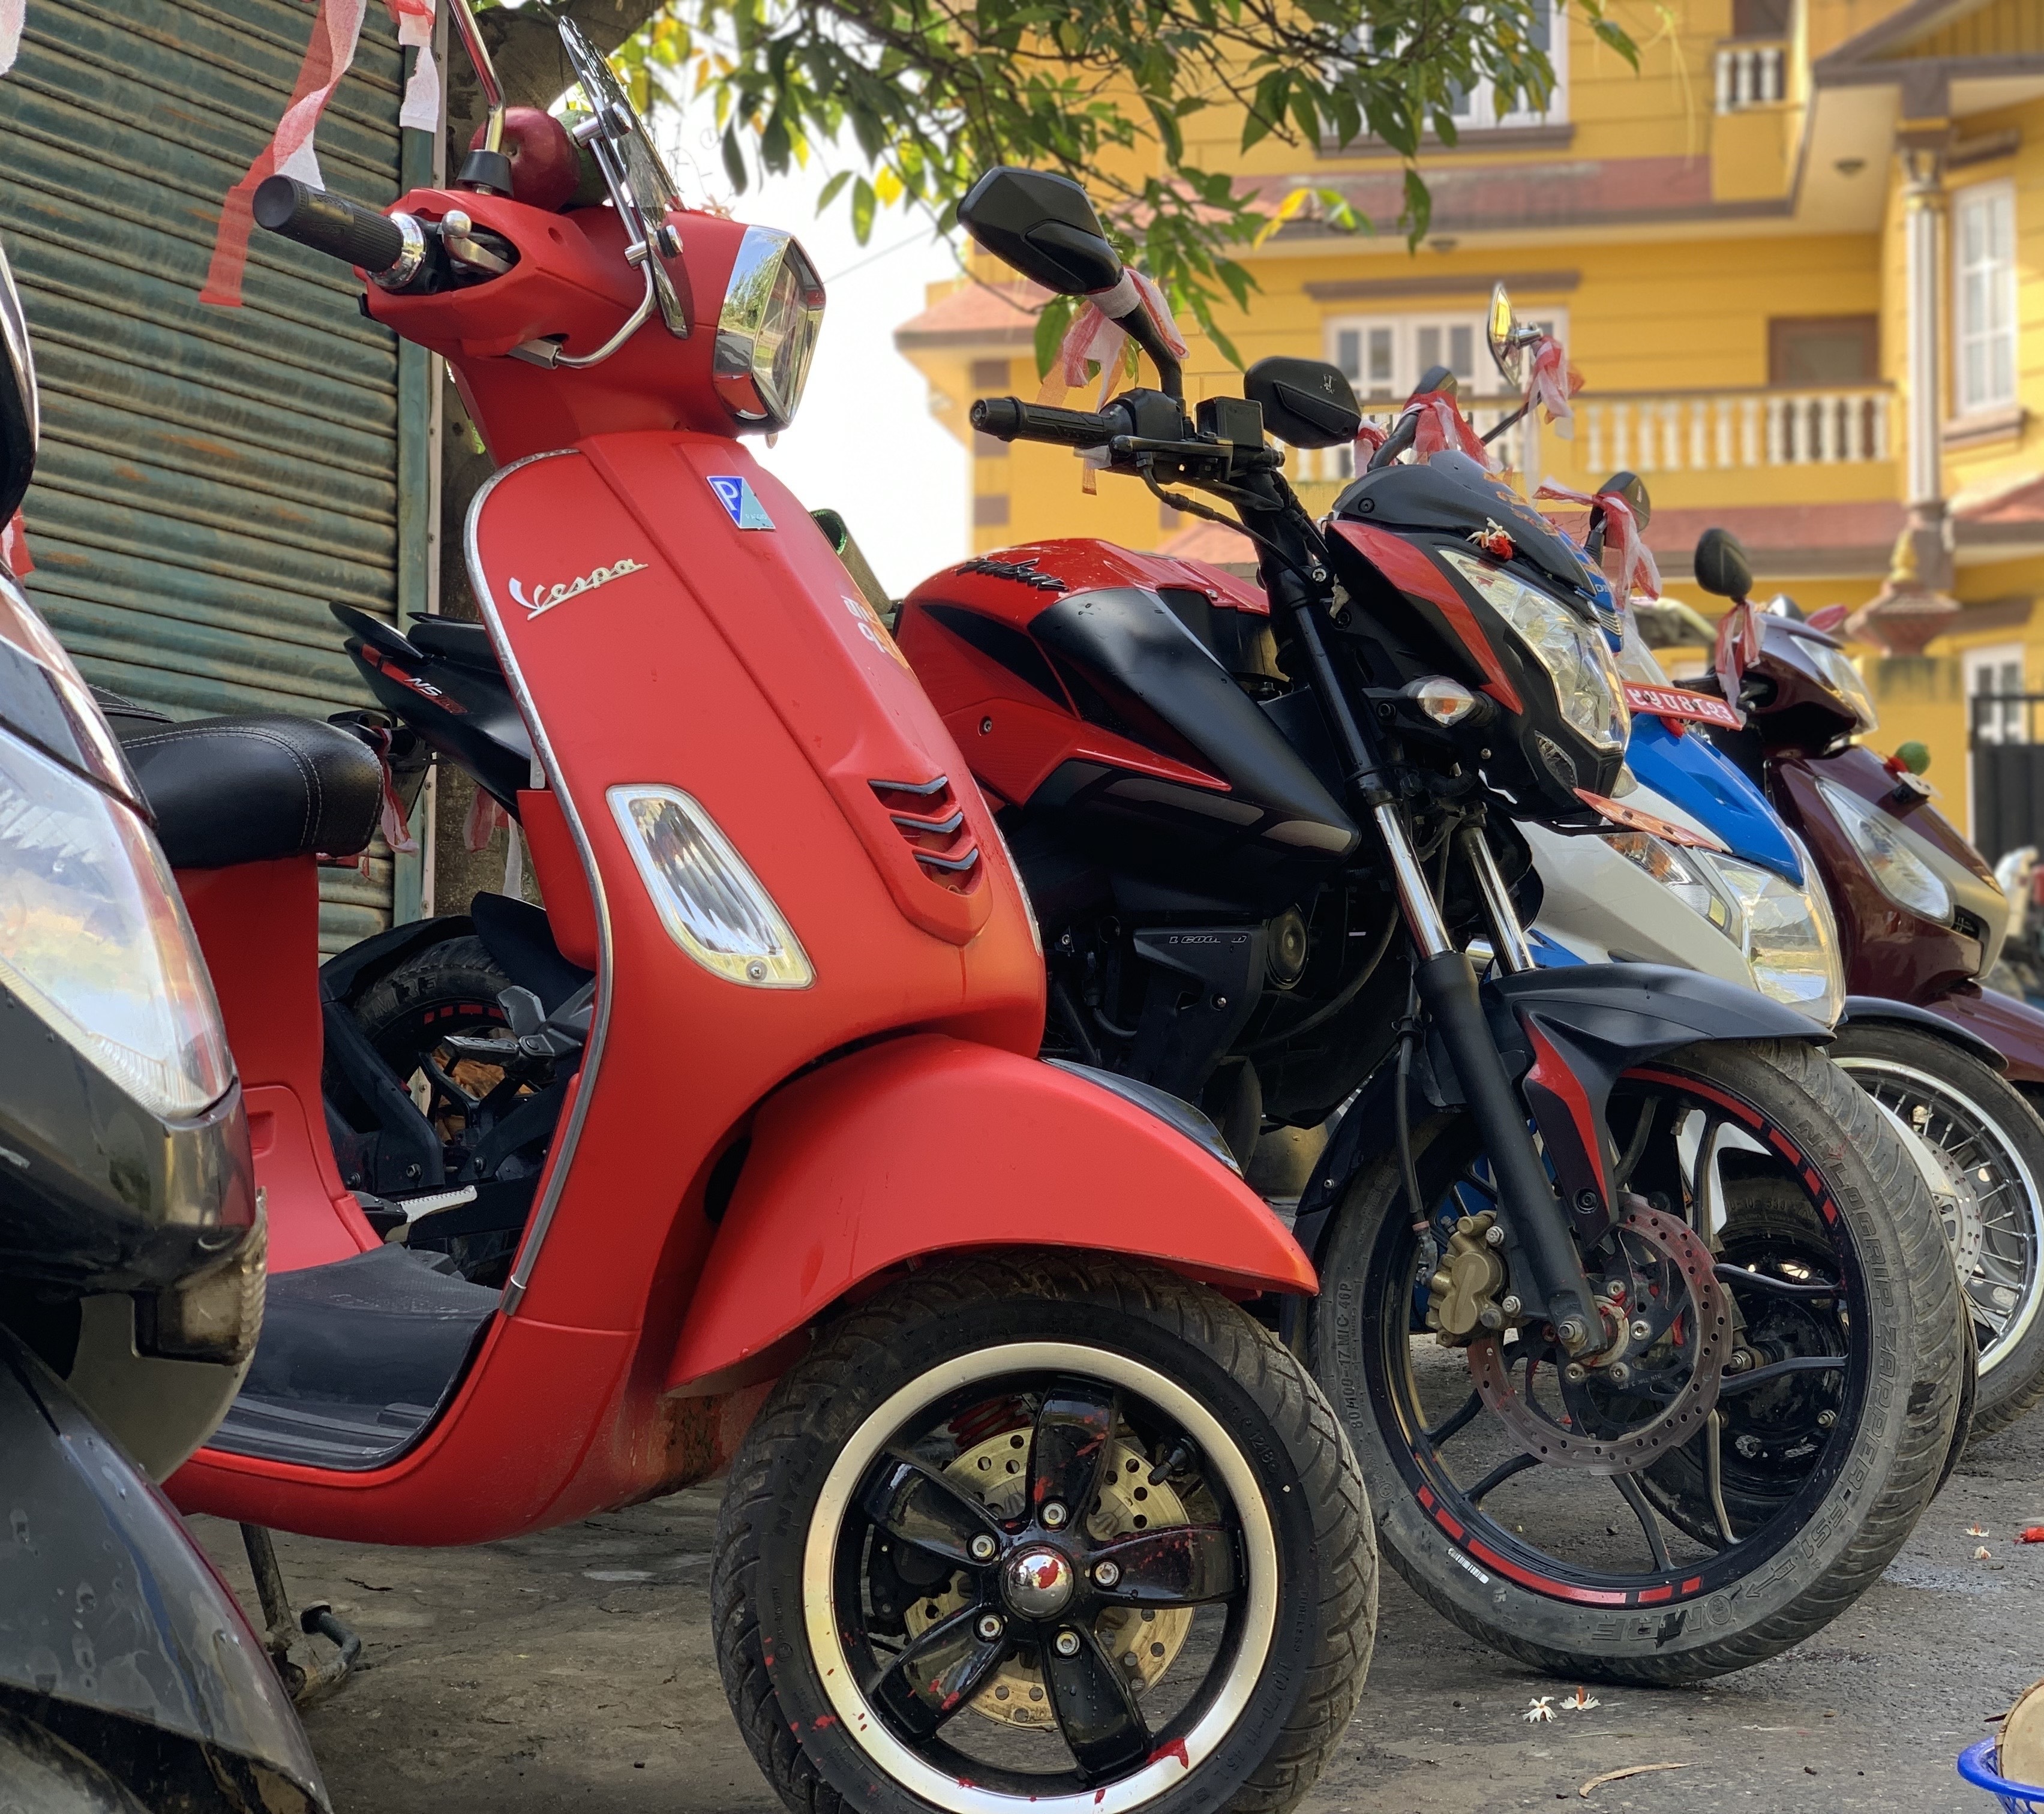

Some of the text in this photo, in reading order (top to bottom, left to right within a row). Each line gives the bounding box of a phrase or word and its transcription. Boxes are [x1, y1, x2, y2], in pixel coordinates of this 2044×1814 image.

[714, 481, 739, 511] P
[509, 558, 649, 620] Vespa
[404, 678, 442, 696] NS
[1337, 1282, 1353, 1310] 46P
[1591, 1606, 1703, 1642] MRF
